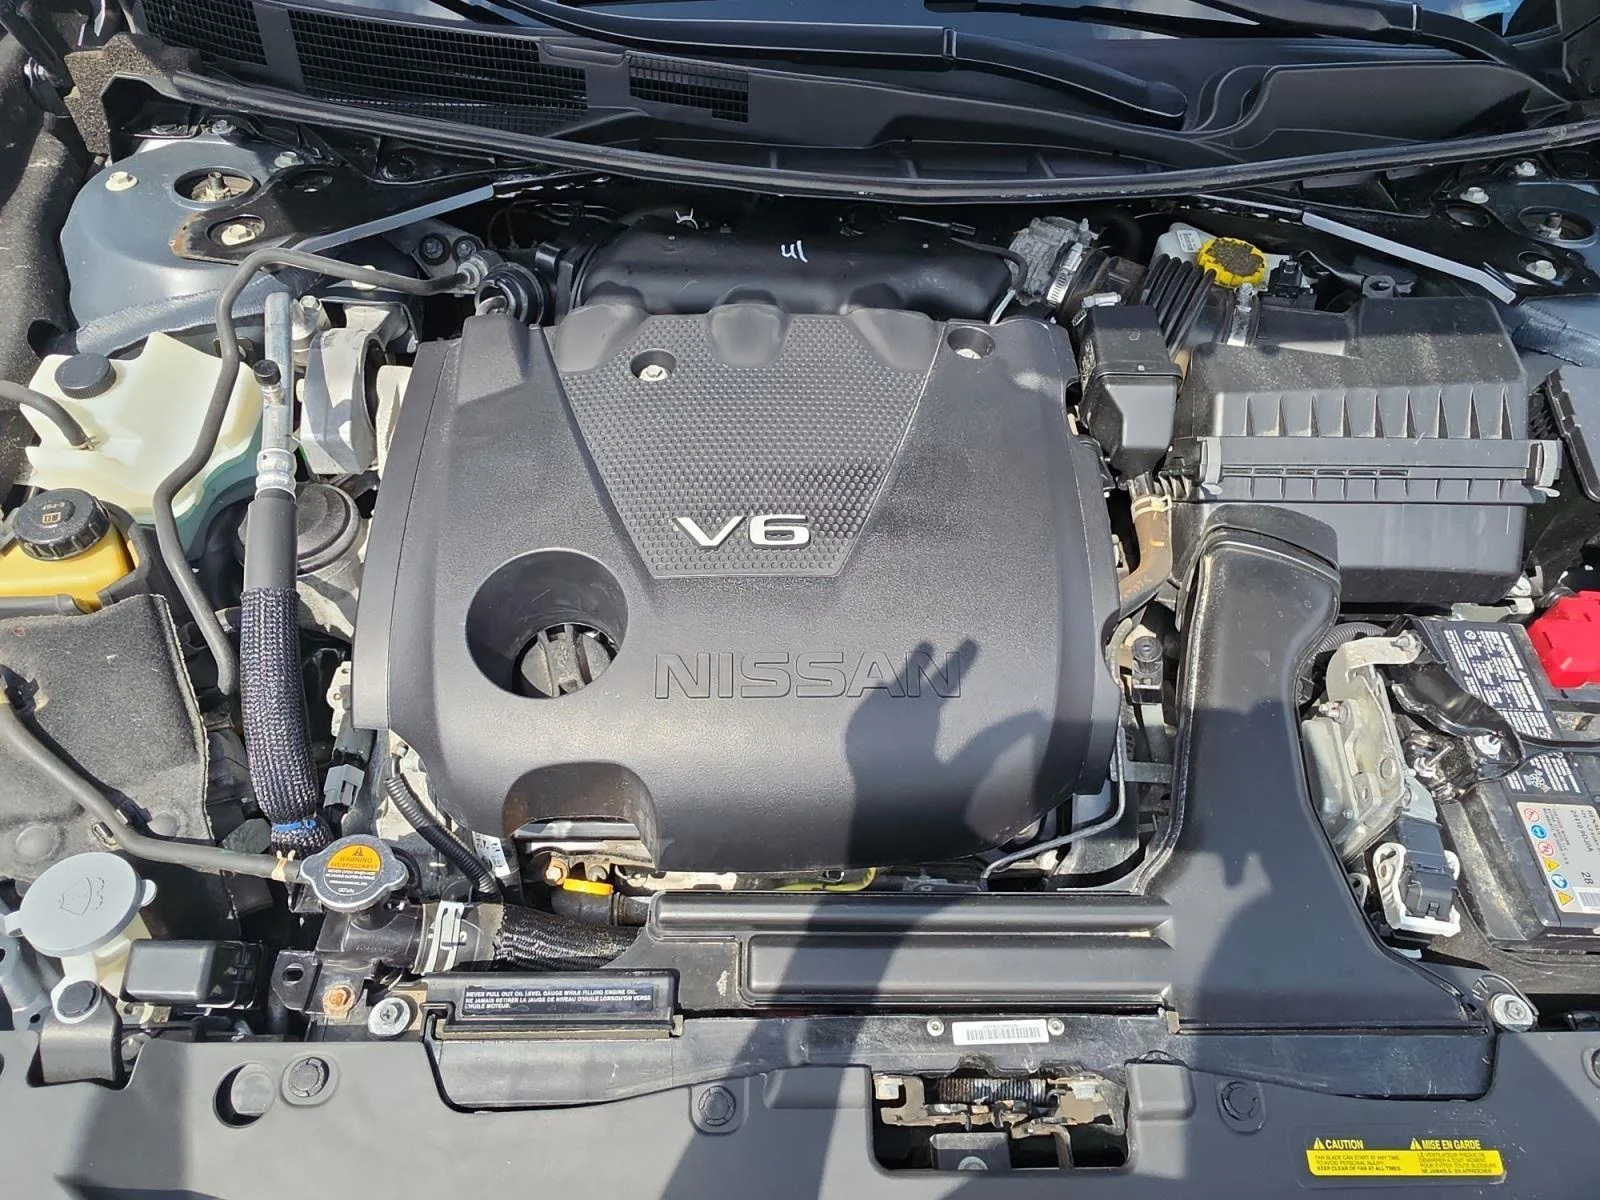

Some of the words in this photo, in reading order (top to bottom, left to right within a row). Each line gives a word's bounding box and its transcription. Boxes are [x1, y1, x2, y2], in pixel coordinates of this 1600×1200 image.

[672, 514, 811, 550] V6
[655, 651, 962, 699] NISSAN
[1325, 1139, 1364, 1150] CAUTION
[1421, 1139, 1442, 1150] MISE
[1441, 1139, 1453, 1150] EN
[1453, 1139, 1482, 1150] GARDE
